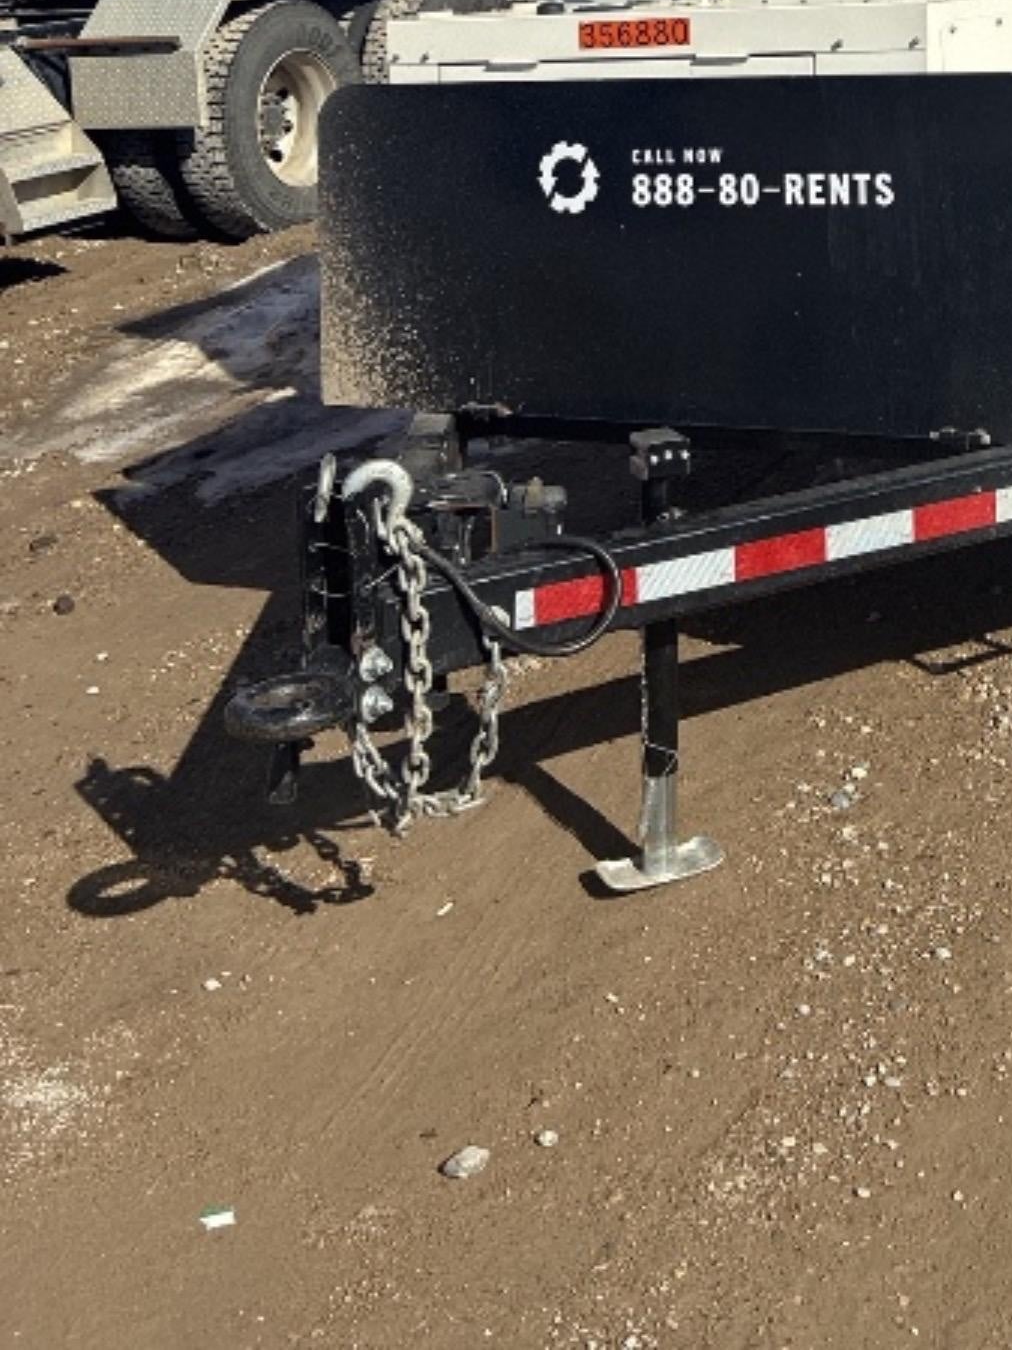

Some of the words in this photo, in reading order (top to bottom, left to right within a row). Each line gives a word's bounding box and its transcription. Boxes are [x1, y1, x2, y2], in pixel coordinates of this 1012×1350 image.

[580, 18, 689, 48] 356880
[631, 148, 675, 165] CALL
[682, 147, 723, 164] NOW
[631, 172, 896, 207] 888-80-RENTS
